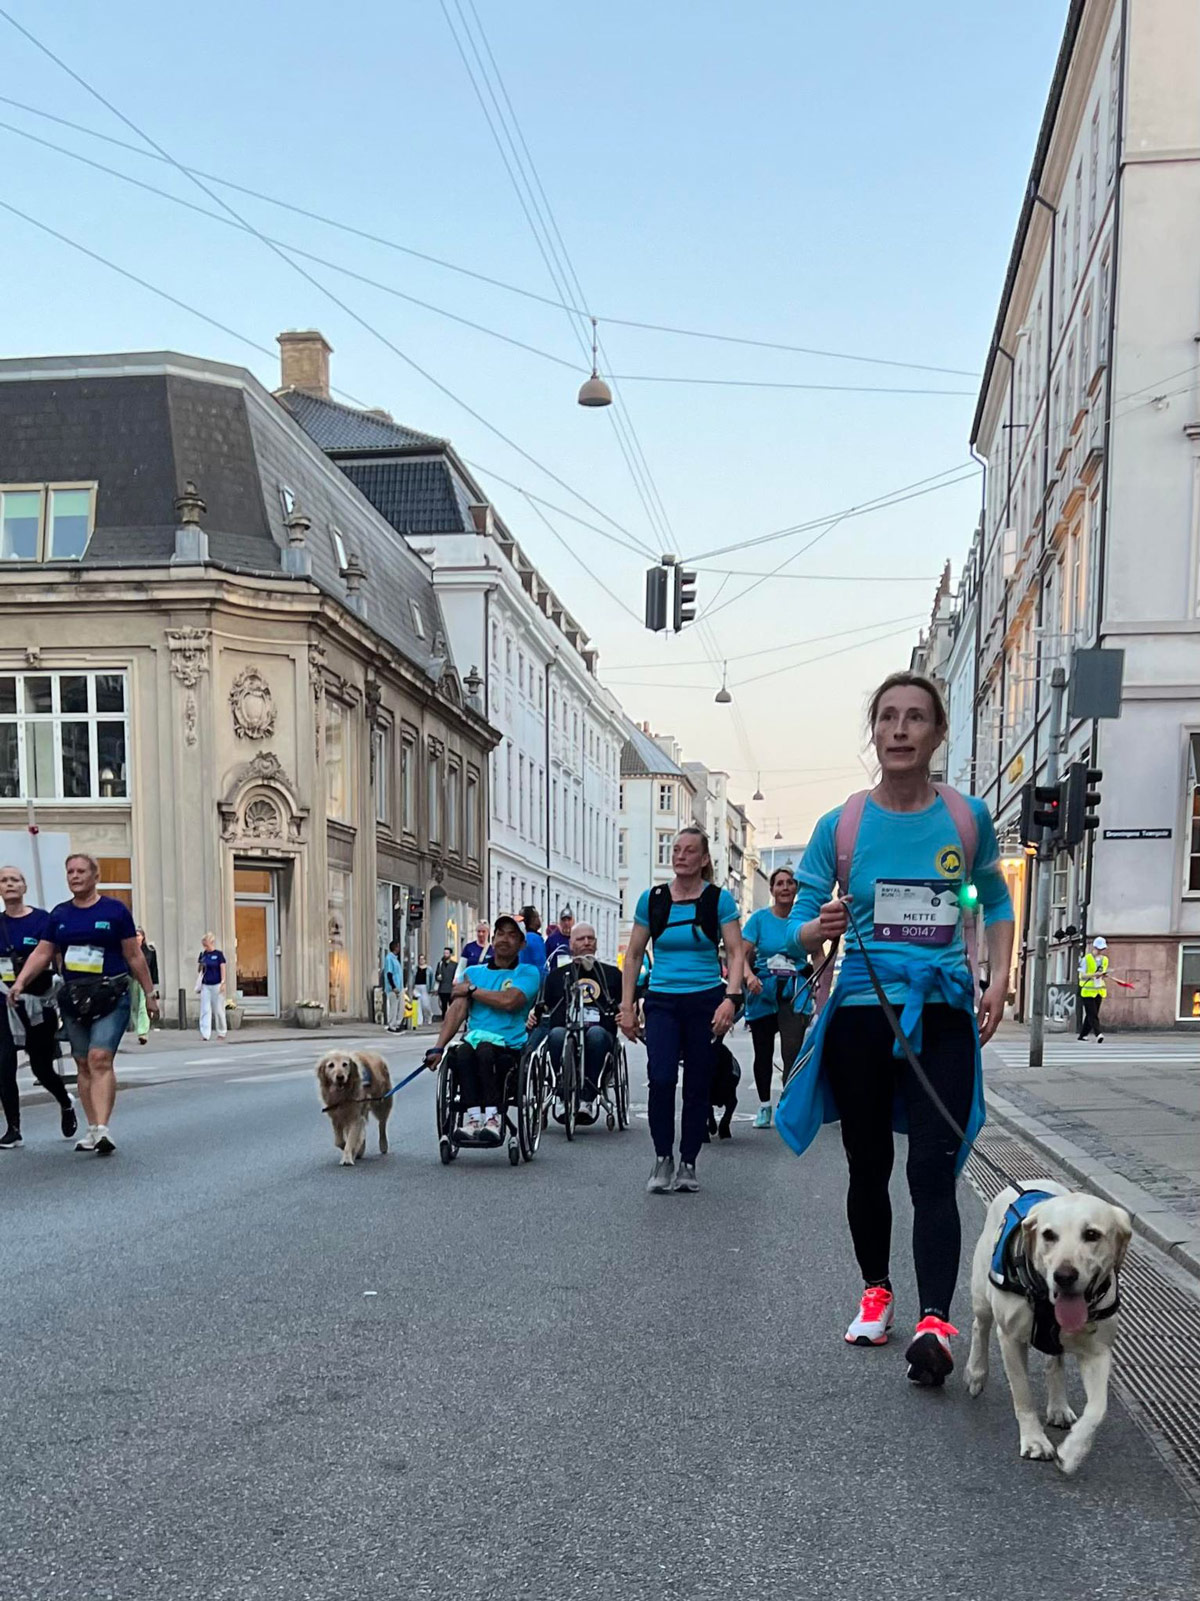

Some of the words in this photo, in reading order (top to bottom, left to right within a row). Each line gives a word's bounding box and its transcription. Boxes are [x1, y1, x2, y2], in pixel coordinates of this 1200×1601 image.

[903, 913, 937, 921] METTE
[882, 927, 891, 936] G
[901, 926, 937, 937] 90147
